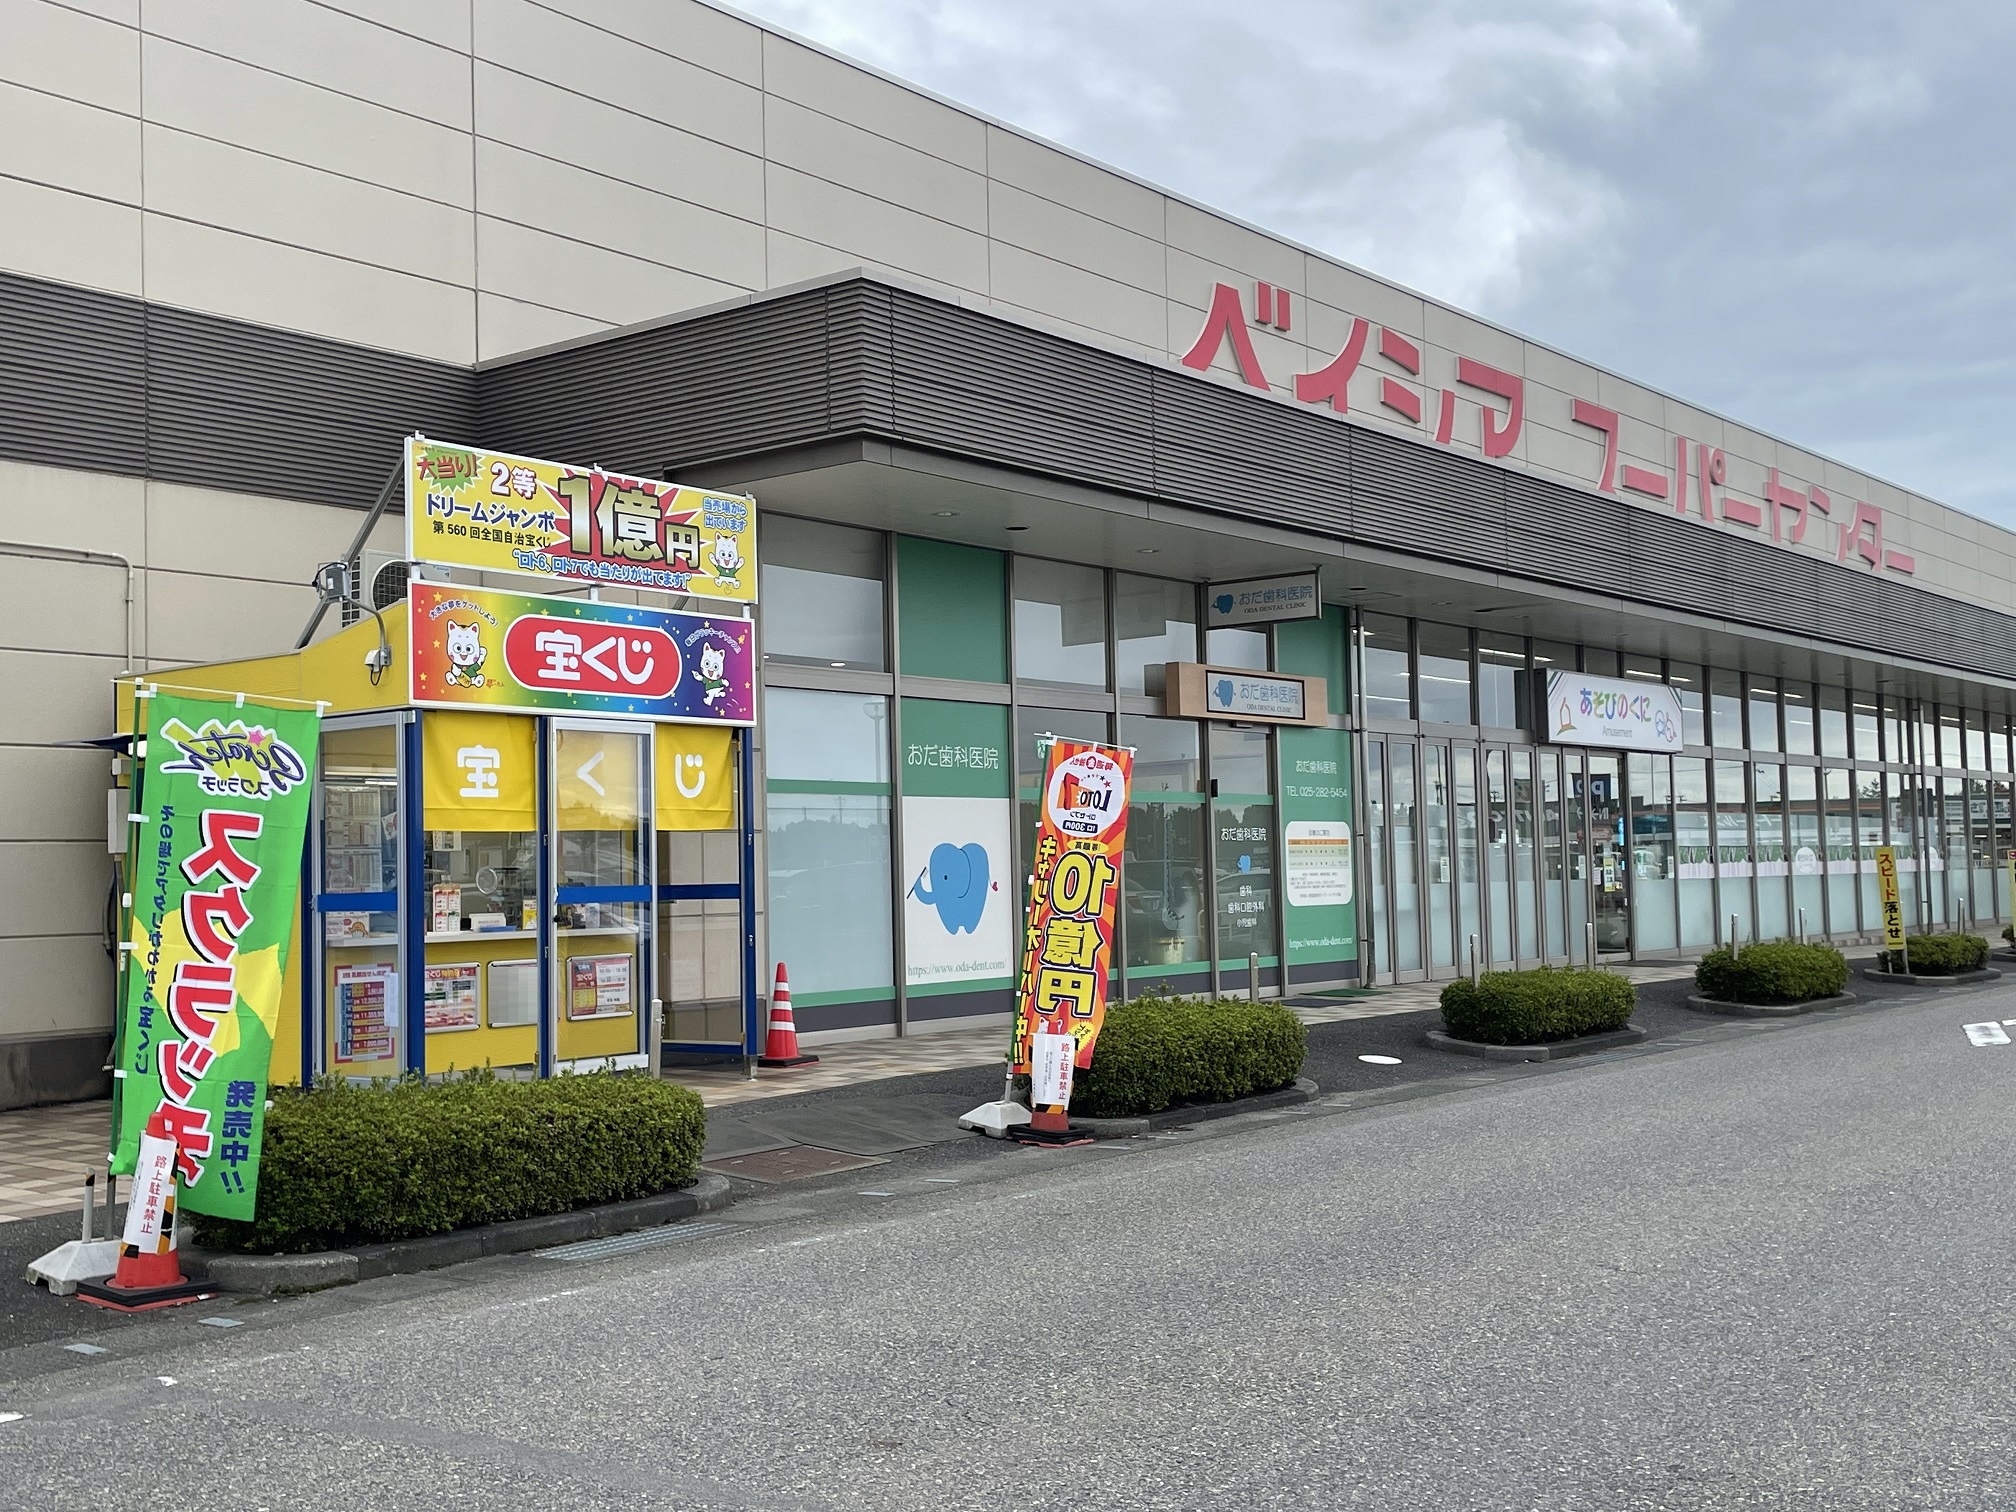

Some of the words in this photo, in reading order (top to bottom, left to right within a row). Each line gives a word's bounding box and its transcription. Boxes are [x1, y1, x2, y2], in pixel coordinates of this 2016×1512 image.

[416, 454, 478, 480] 大当り!
[490, 461, 537, 500] 2等
[426, 493, 555, 533] ドリームジャンボ
[703, 497, 747, 517] 当売場から
[557, 475, 700, 569] 1億円
[704, 514, 747, 533] 出ています
[432, 519, 445, 534] 第
[447, 523, 467, 537] 560
[469, 526, 551, 548] 回全国自治宝くじ
[1239, 585, 1313, 606] おだ歯科医院
[1259, 604, 1284, 613] DENTAL
[535, 629, 655, 685] 宝くじ
[1240, 682, 1299, 704] おだ歯科医院
[1258, 704, 1276, 713] DENTAL
[1277, 706, 1291, 714] CLINIC
[1580, 687, 1652, 723] あそびのくに
[1602, 725, 1633, 738] Amusement
[908, 743, 999, 770] おだ歯科医院
[1296, 760, 1338, 775] おだ歯科医院
[457, 744, 500, 798] 宝
[675, 753, 705, 798] じ
[1286, 785, 1299, 797] TEL
[1300, 786, 1348, 798] 025-282-5454
[1221, 827, 1267, 841] おだ歯科医院
[1239, 885, 1252, 897] 歯科
[1228, 901, 1264, 914] 歯科口腔外科
[907, 957, 1008, 979] https://www.oda-dent.com/
[1058, 1042, 1071, 1100] 路上駐車禁止
[140, 1155, 167, 1235] 路上駐車禁止
